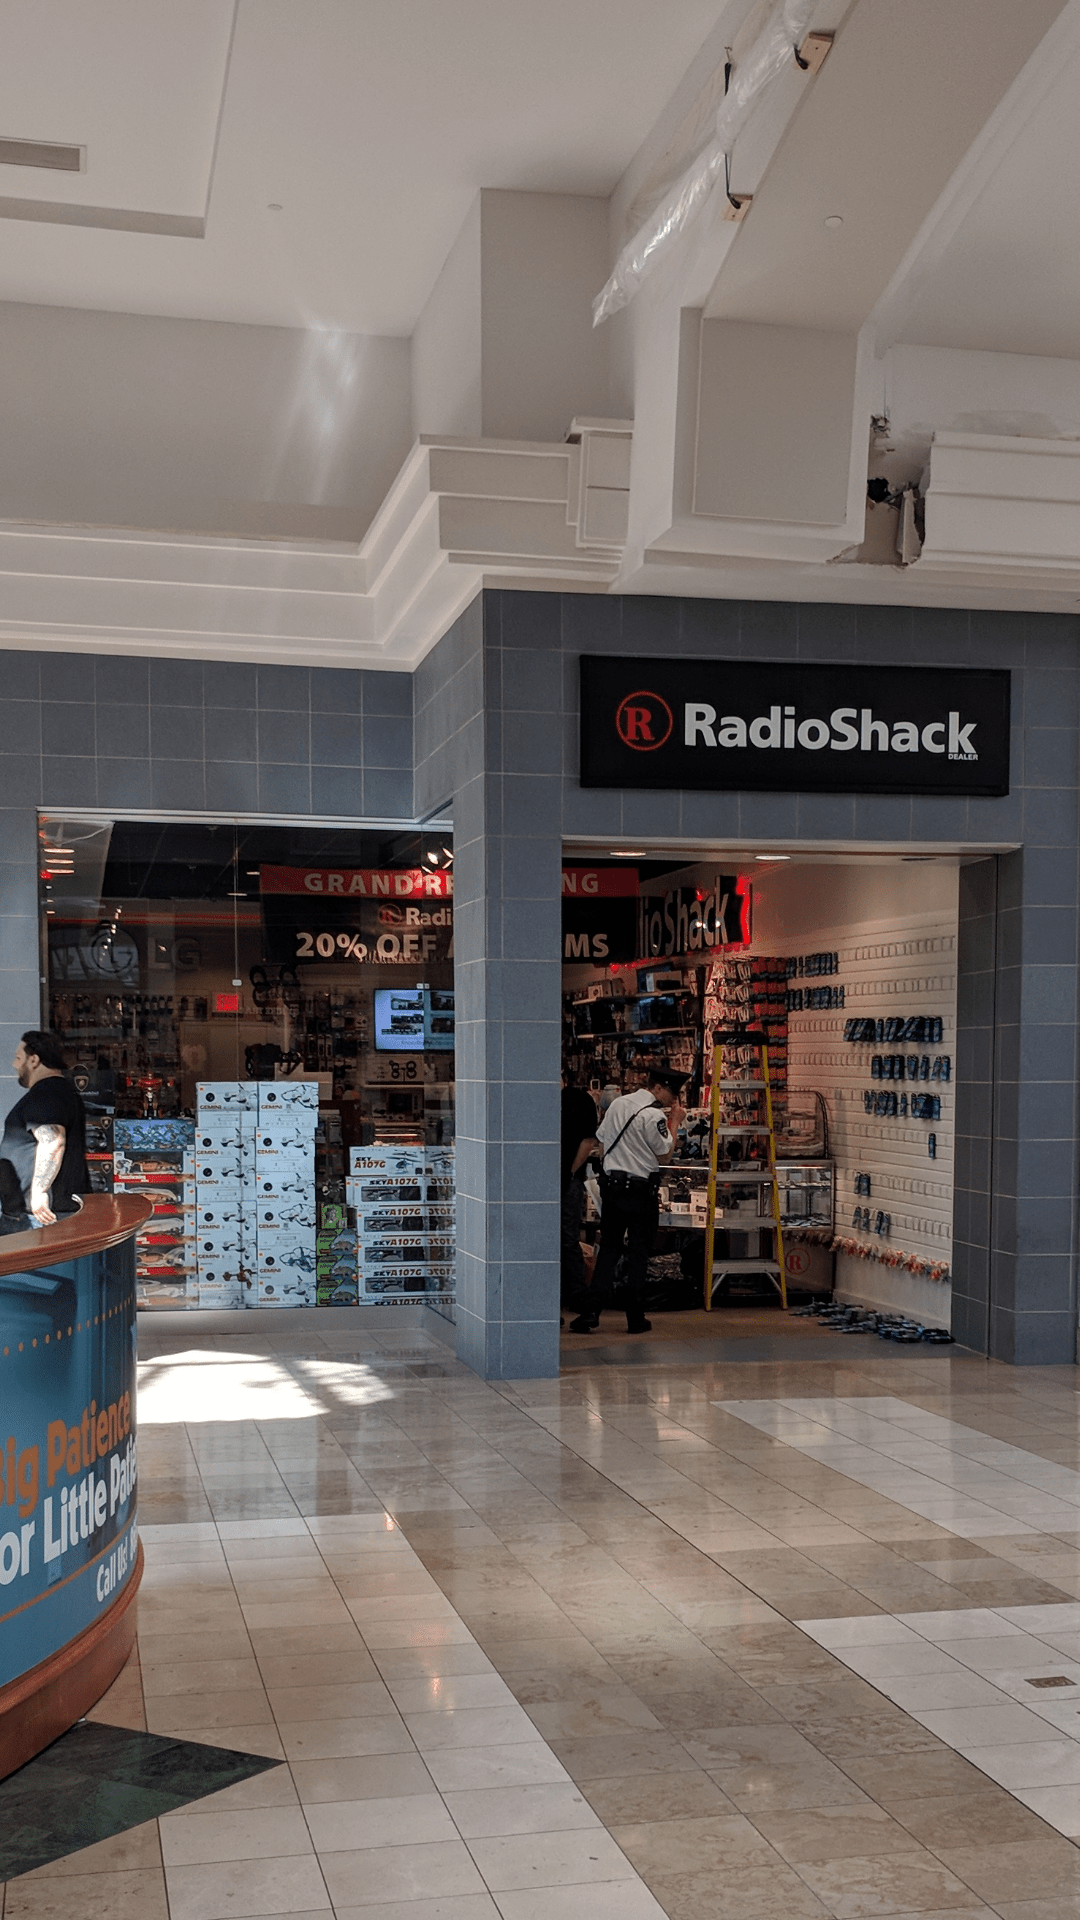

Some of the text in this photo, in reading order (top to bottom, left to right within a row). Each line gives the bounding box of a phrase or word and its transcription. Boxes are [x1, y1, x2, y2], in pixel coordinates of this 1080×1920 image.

[684, 703, 978, 754] RadioShack
[948, 753, 979, 761] DEALER
[304, 873, 413, 895] GRAND
[639, 876, 729, 958] ioShack
[296, 932, 368, 958] 20%
[376, 933, 437, 959] OFF
[0, 1391, 130, 1518] ig Patience
[44, 1472, 107, 1564] Little
[96, 1553, 117, 1602] Call
